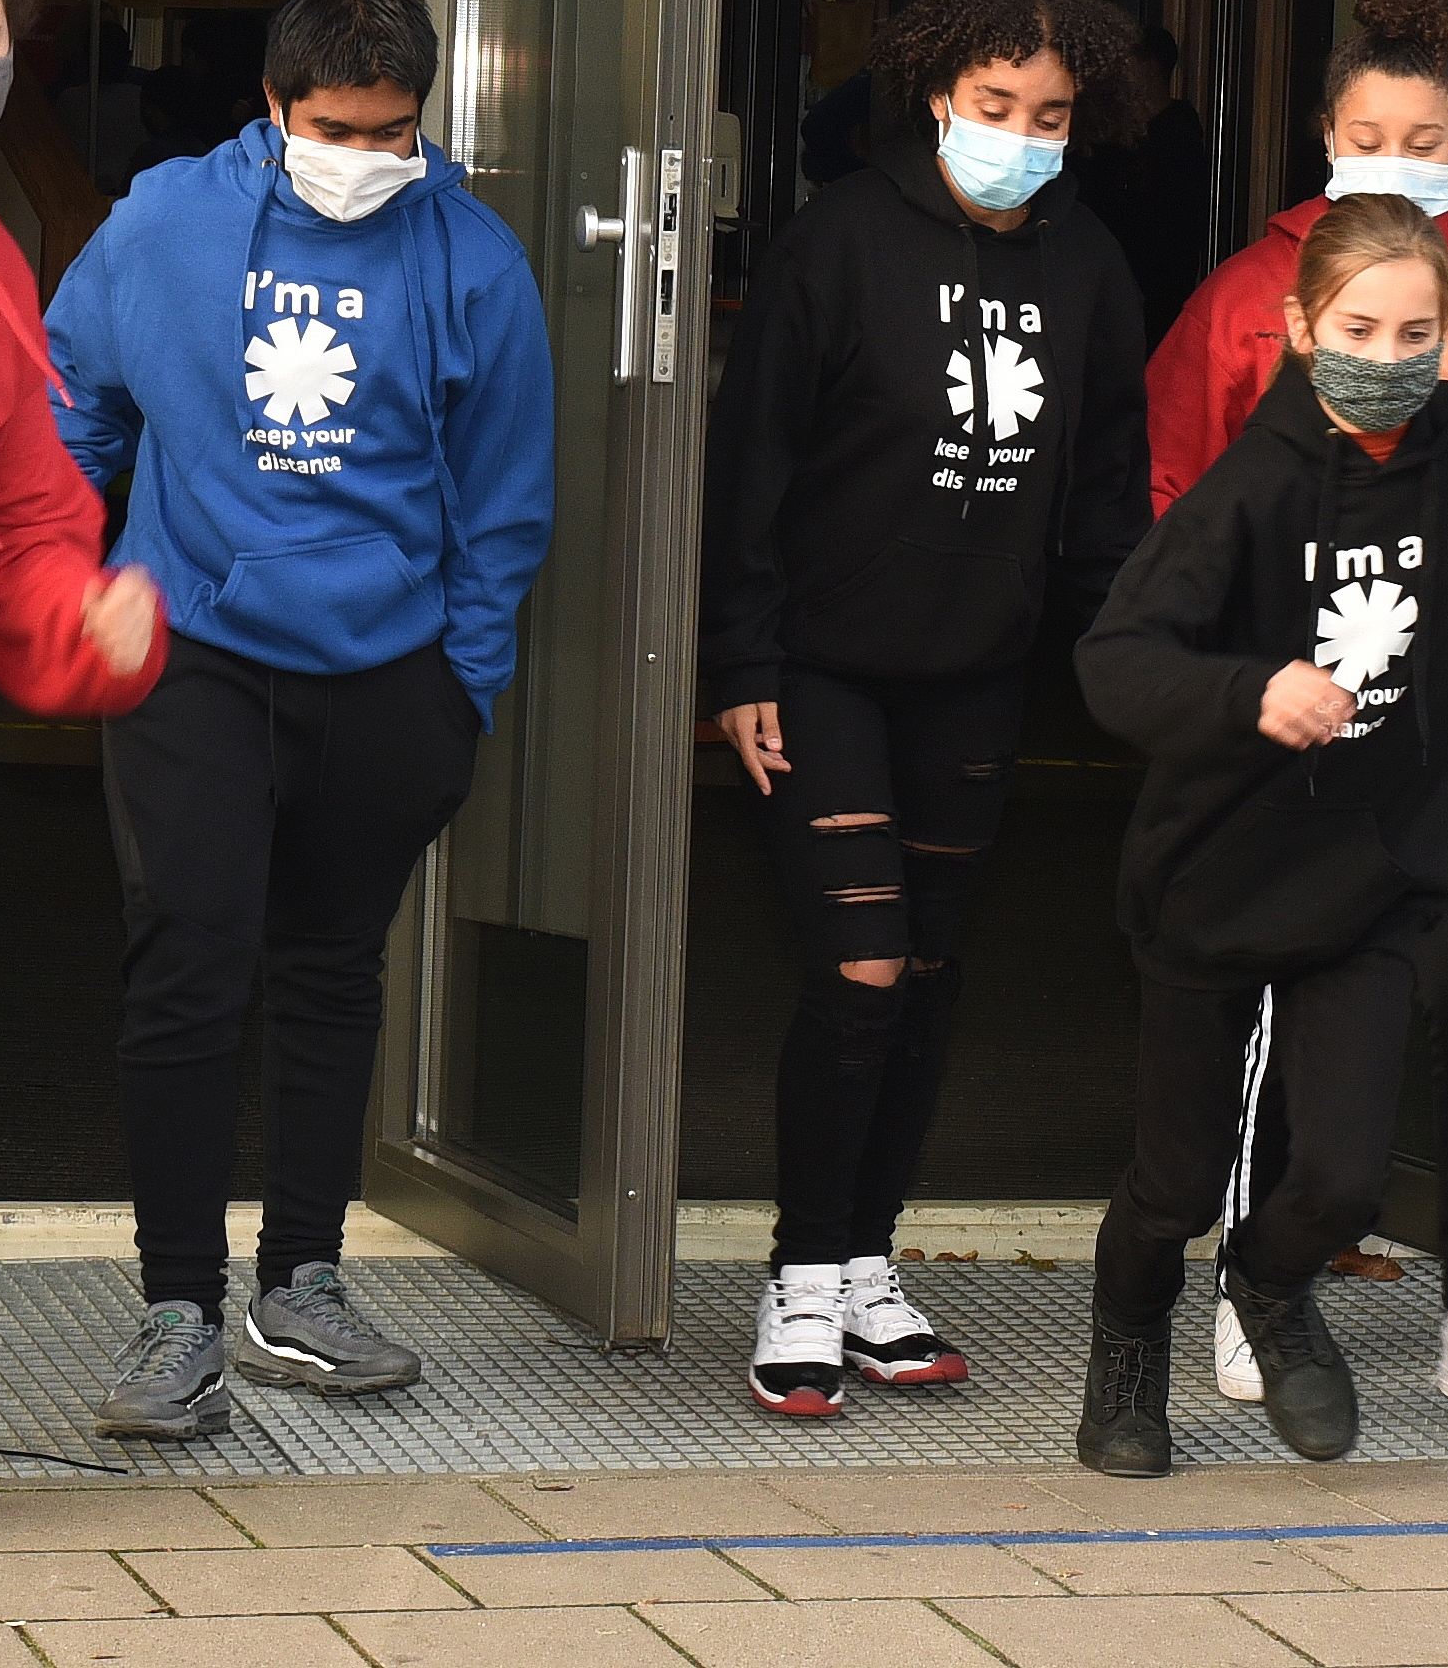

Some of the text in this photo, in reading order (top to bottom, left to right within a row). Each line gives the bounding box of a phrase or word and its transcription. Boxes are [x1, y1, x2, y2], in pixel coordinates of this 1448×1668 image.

[245, 269, 363, 319] I'm a
[1019, 303, 1042, 333] a
[301, 429, 356, 448] your
[934, 437, 1036, 467] kee your
[257, 451, 342, 475] distance
[932, 467, 1018, 493] disnce
[1397, 535, 1424, 570] a
